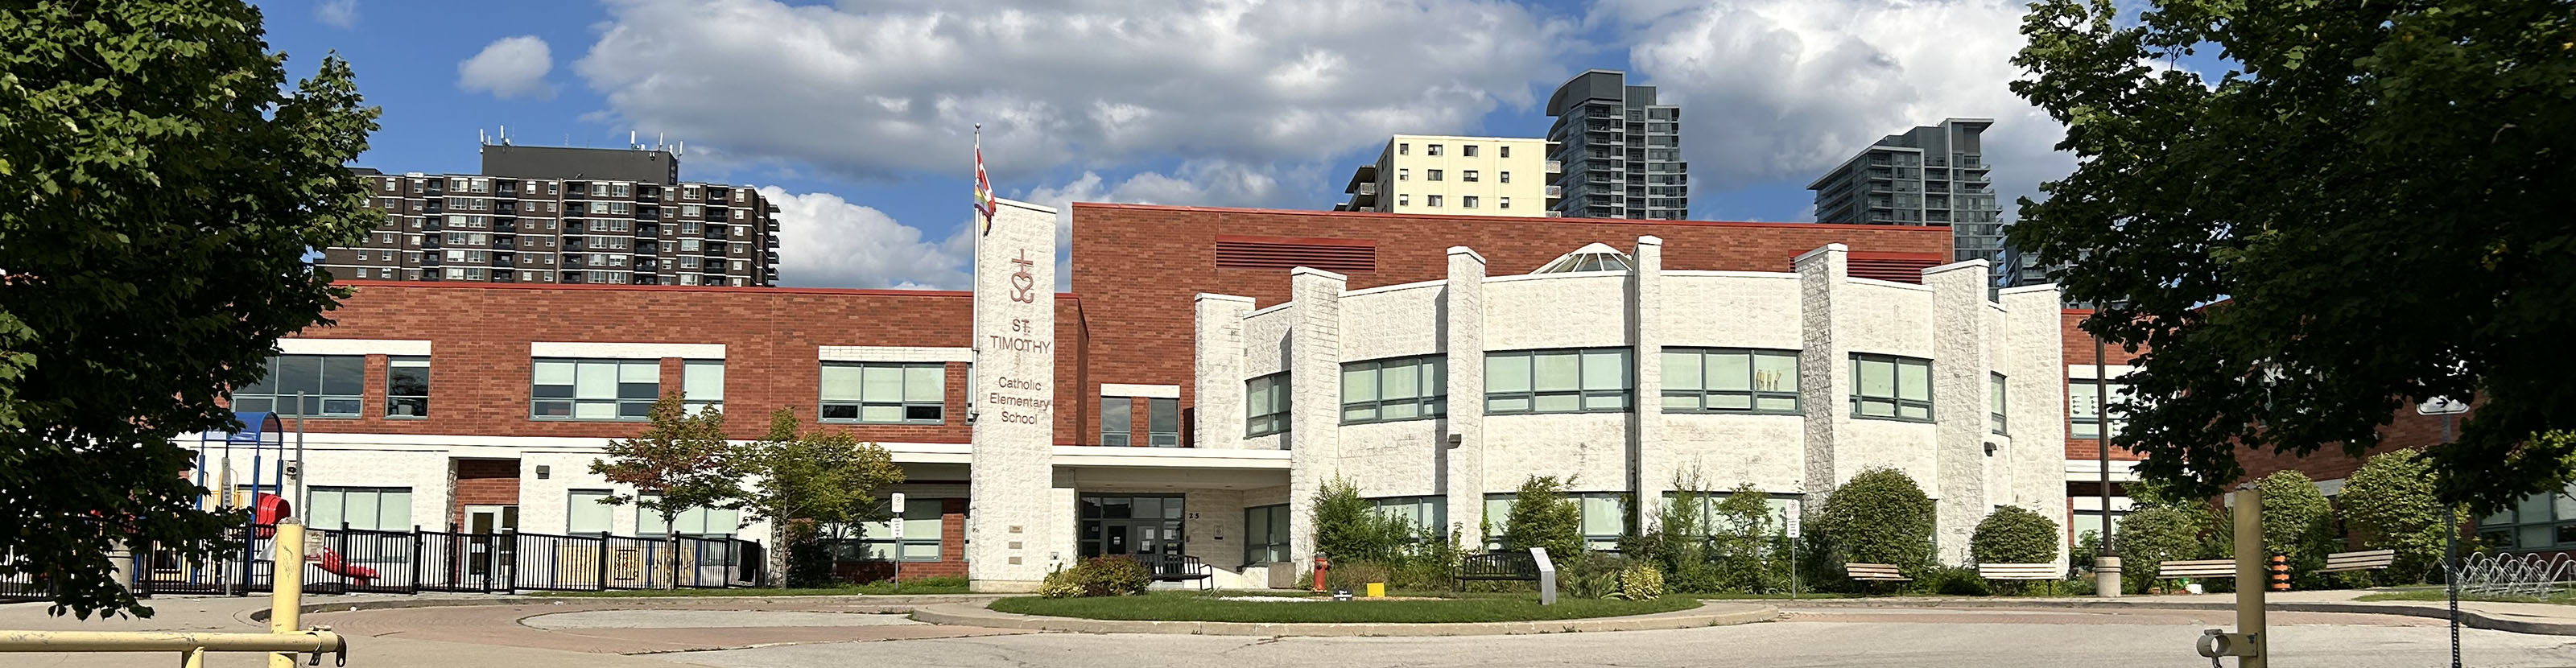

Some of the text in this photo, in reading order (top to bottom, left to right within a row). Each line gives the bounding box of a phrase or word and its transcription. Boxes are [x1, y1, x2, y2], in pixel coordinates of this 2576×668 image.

[1012, 318, 1031, 333] ST.
[990, 335, 1051, 353] TIMOTHY
[998, 376, 1042, 391] Catholic
[989, 392, 1050, 411] Elementary
[1001, 410, 1038, 425] School
